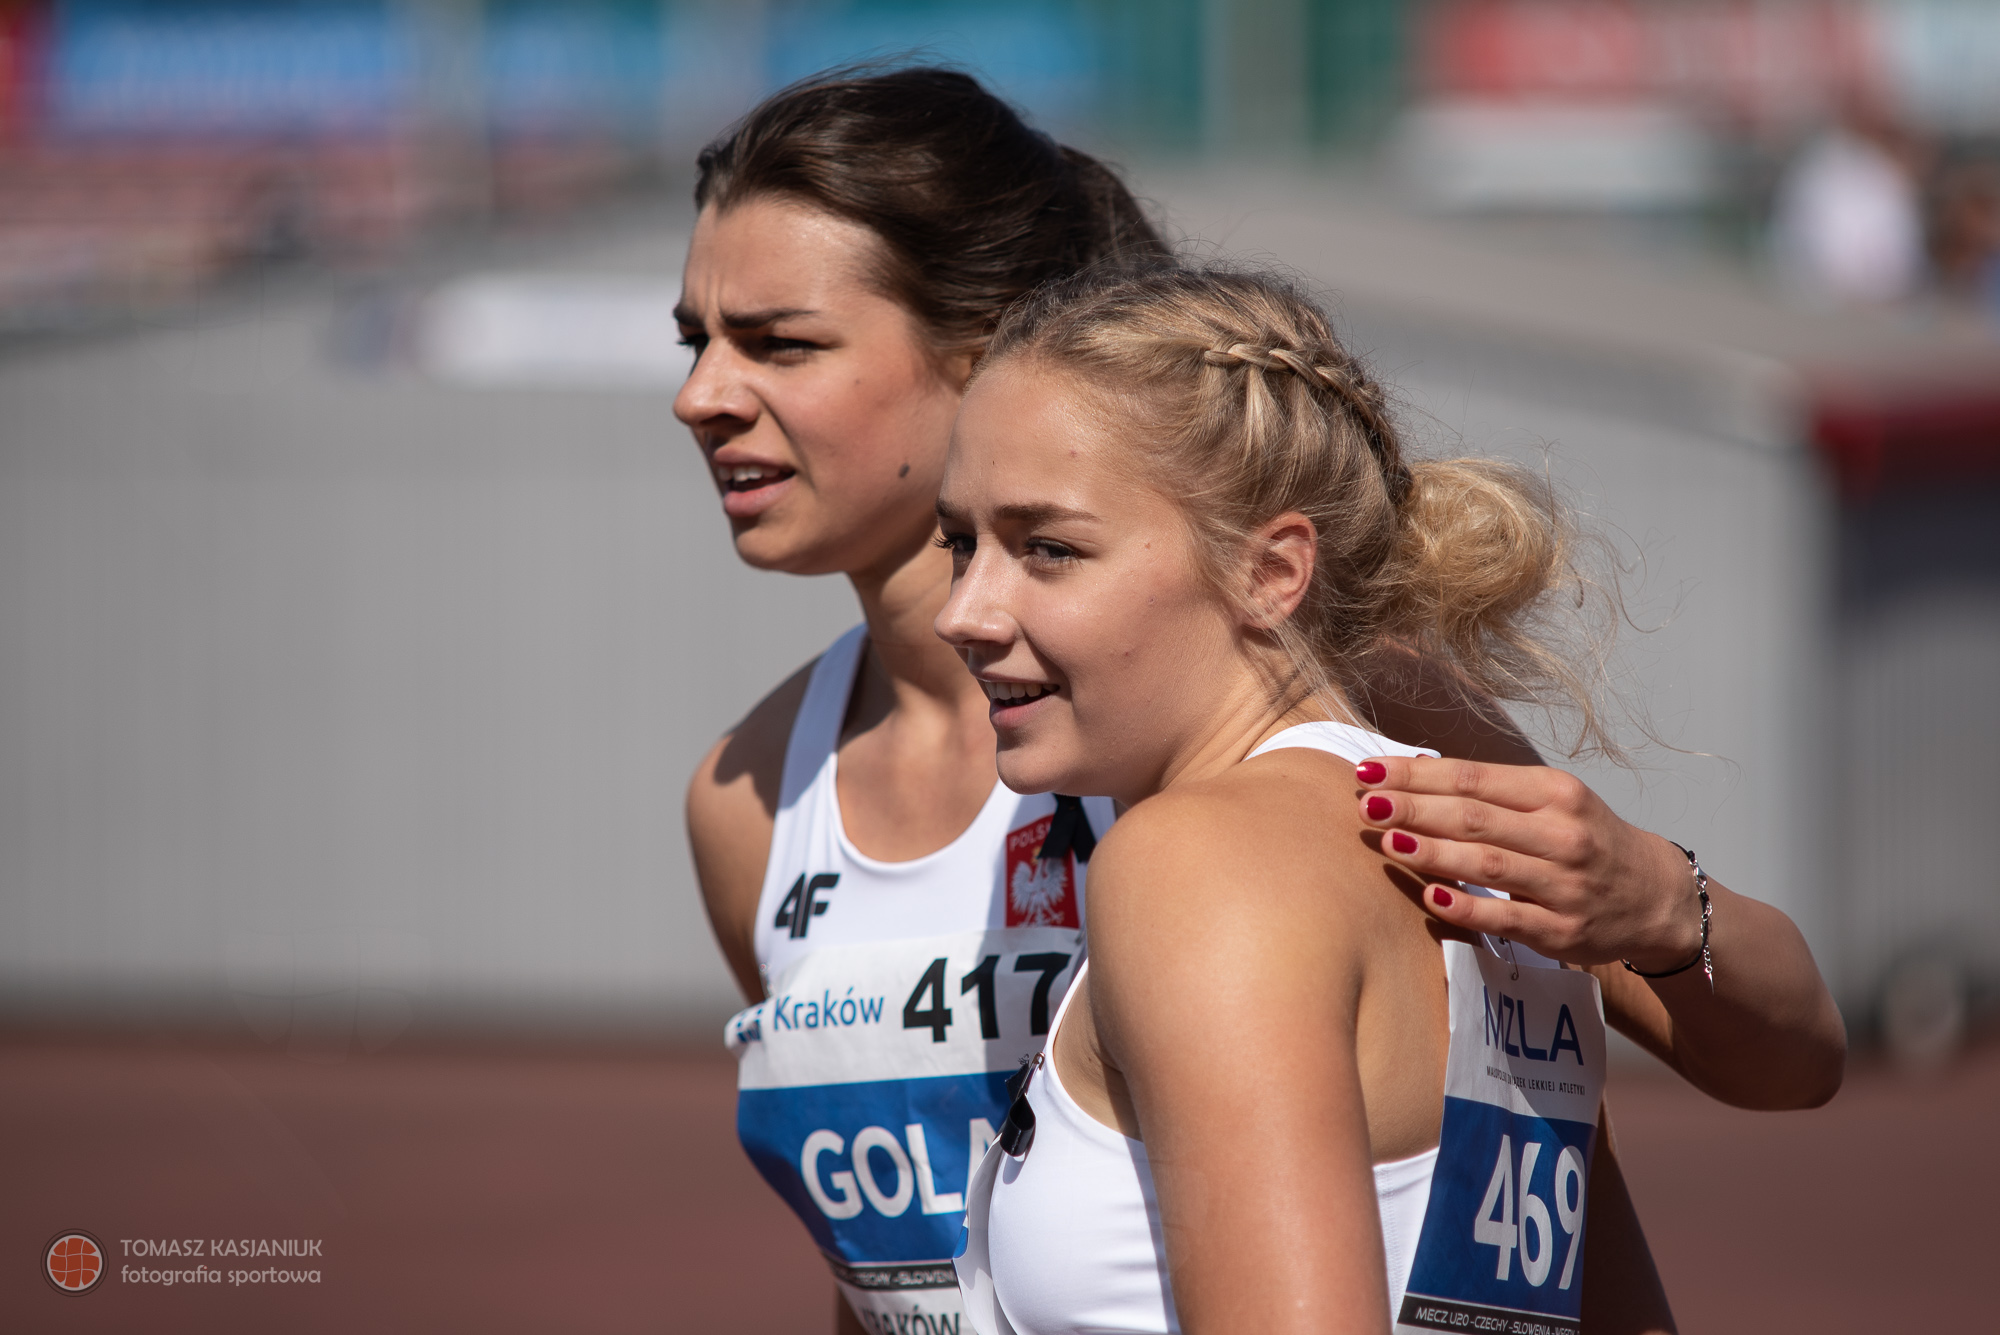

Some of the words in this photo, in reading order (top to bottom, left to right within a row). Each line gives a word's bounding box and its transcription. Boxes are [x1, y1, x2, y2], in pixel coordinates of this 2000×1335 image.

[774, 871, 841, 939] 4F
[774, 986, 884, 1031] Kraków
[903, 952, 1072, 1044] 417
[1484, 985, 1584, 1066] MZLA
[1528, 1079, 1556, 1093] LEKKIEJ
[1559, 1082, 1586, 1096] ATLETYKI
[1474, 1134, 1586, 1290] 469
[1415, 1306, 1449, 1324] MECZ
[1449, 1311, 1470, 1327] U20
